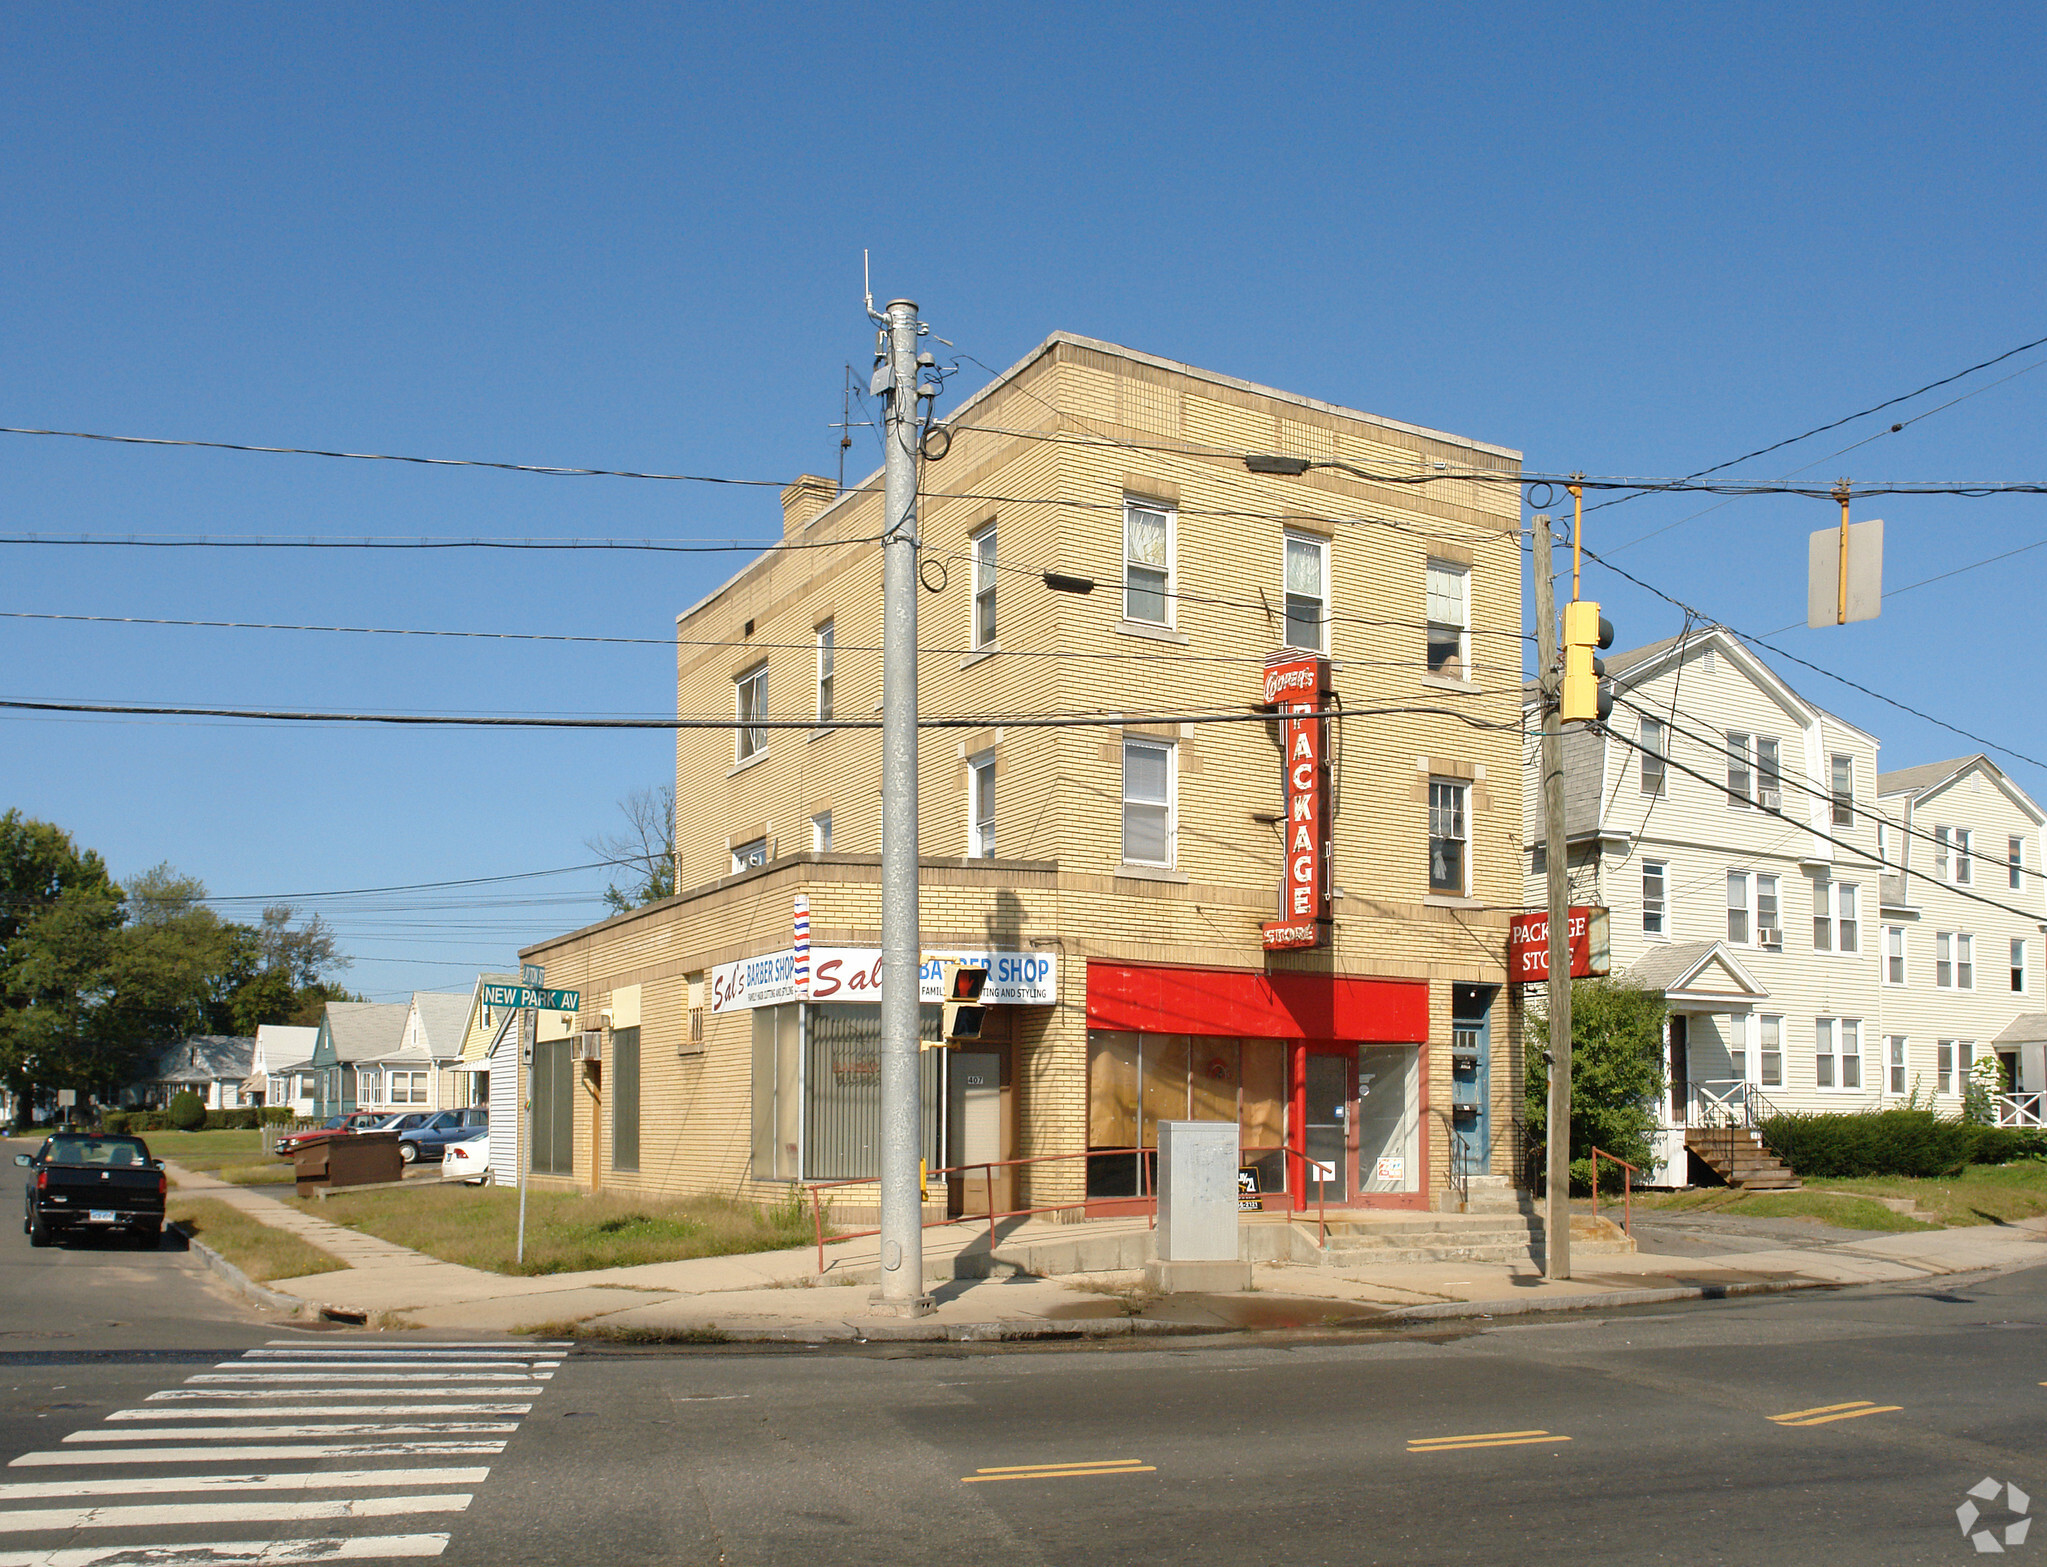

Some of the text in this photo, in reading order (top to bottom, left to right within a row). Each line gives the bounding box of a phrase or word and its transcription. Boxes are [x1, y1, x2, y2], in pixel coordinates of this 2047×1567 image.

[1292, 703, 1313, 915] PACKAGE
[1263, 923, 1313, 943] STORE
[1513, 917, 1585, 944] PACKGE
[998, 958, 1049, 983] SHOP
[713, 955, 795, 1011] Sal's BARBER SHOP
[1001, 988, 1015, 998] AND
[1017, 989, 1046, 999] STYLING
[485, 986, 578, 1009] NEW PARK AV
[968, 1077, 983, 1085] 407
